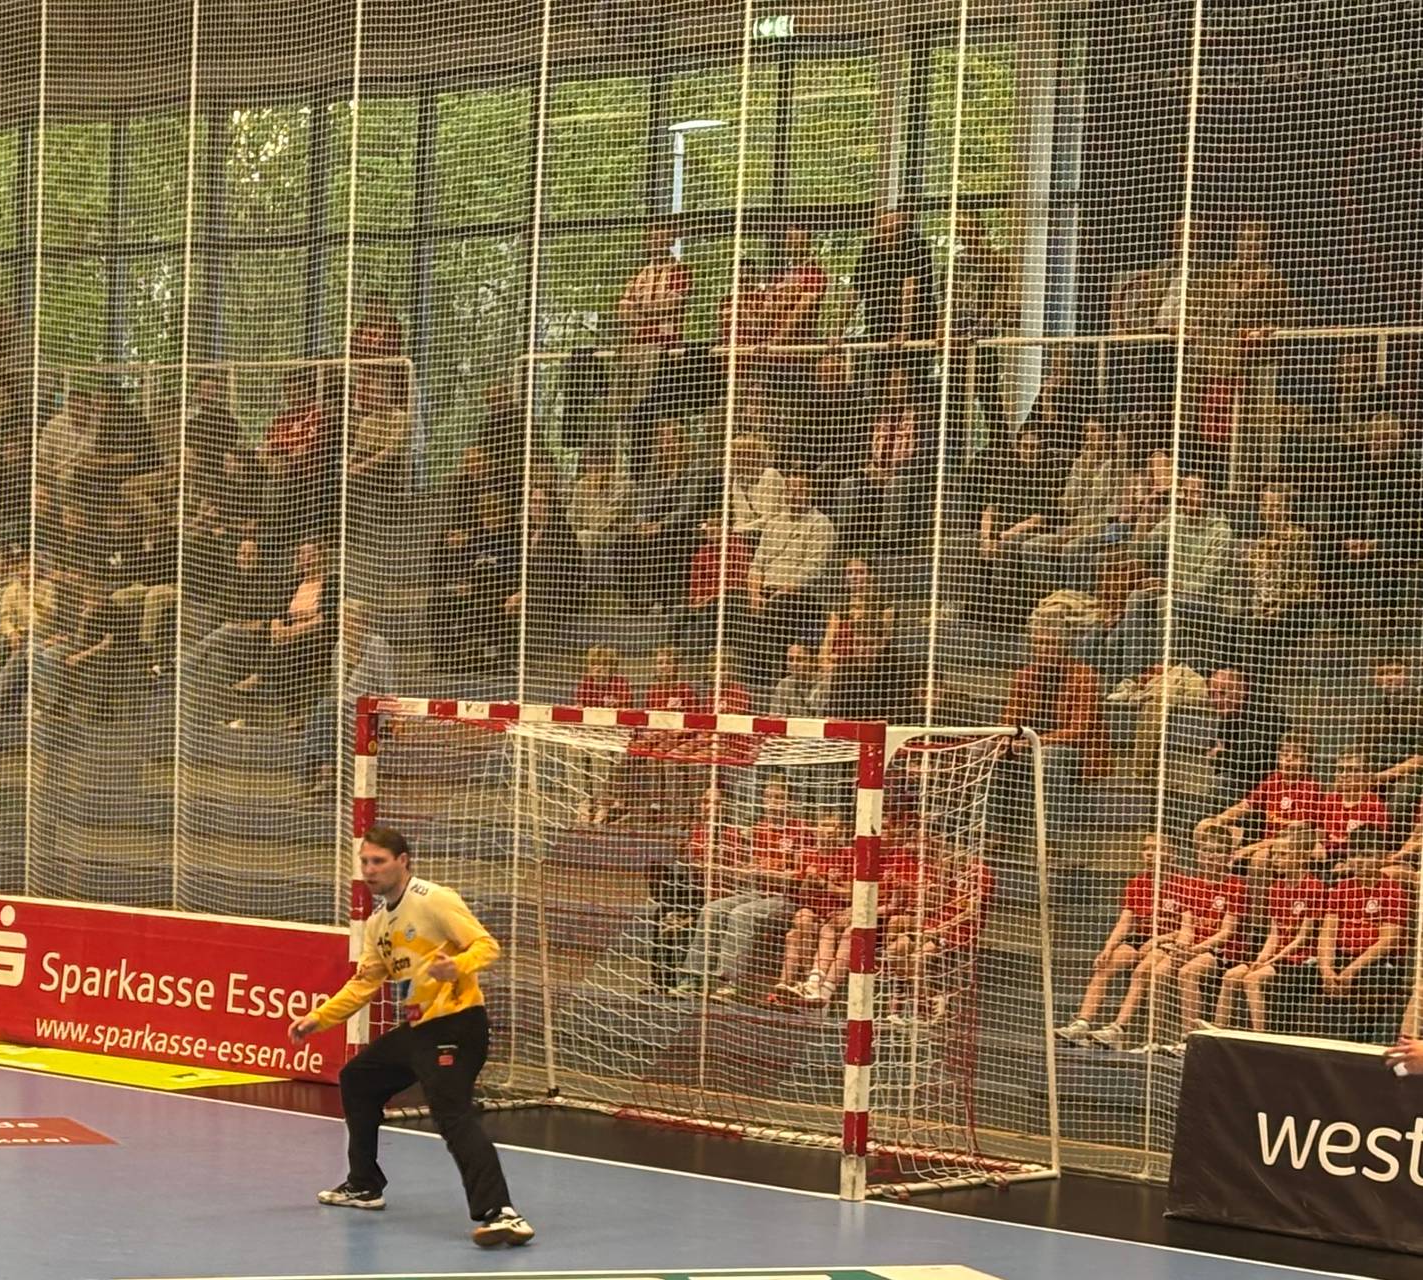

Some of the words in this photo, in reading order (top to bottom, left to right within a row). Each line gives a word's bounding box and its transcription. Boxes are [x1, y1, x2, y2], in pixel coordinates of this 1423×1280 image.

[39, 952, 215, 1012] Sparkasse
[35, 1017, 324, 1074] www.sparkasse-essen.de
[1257, 1111, 1423, 1187] west
